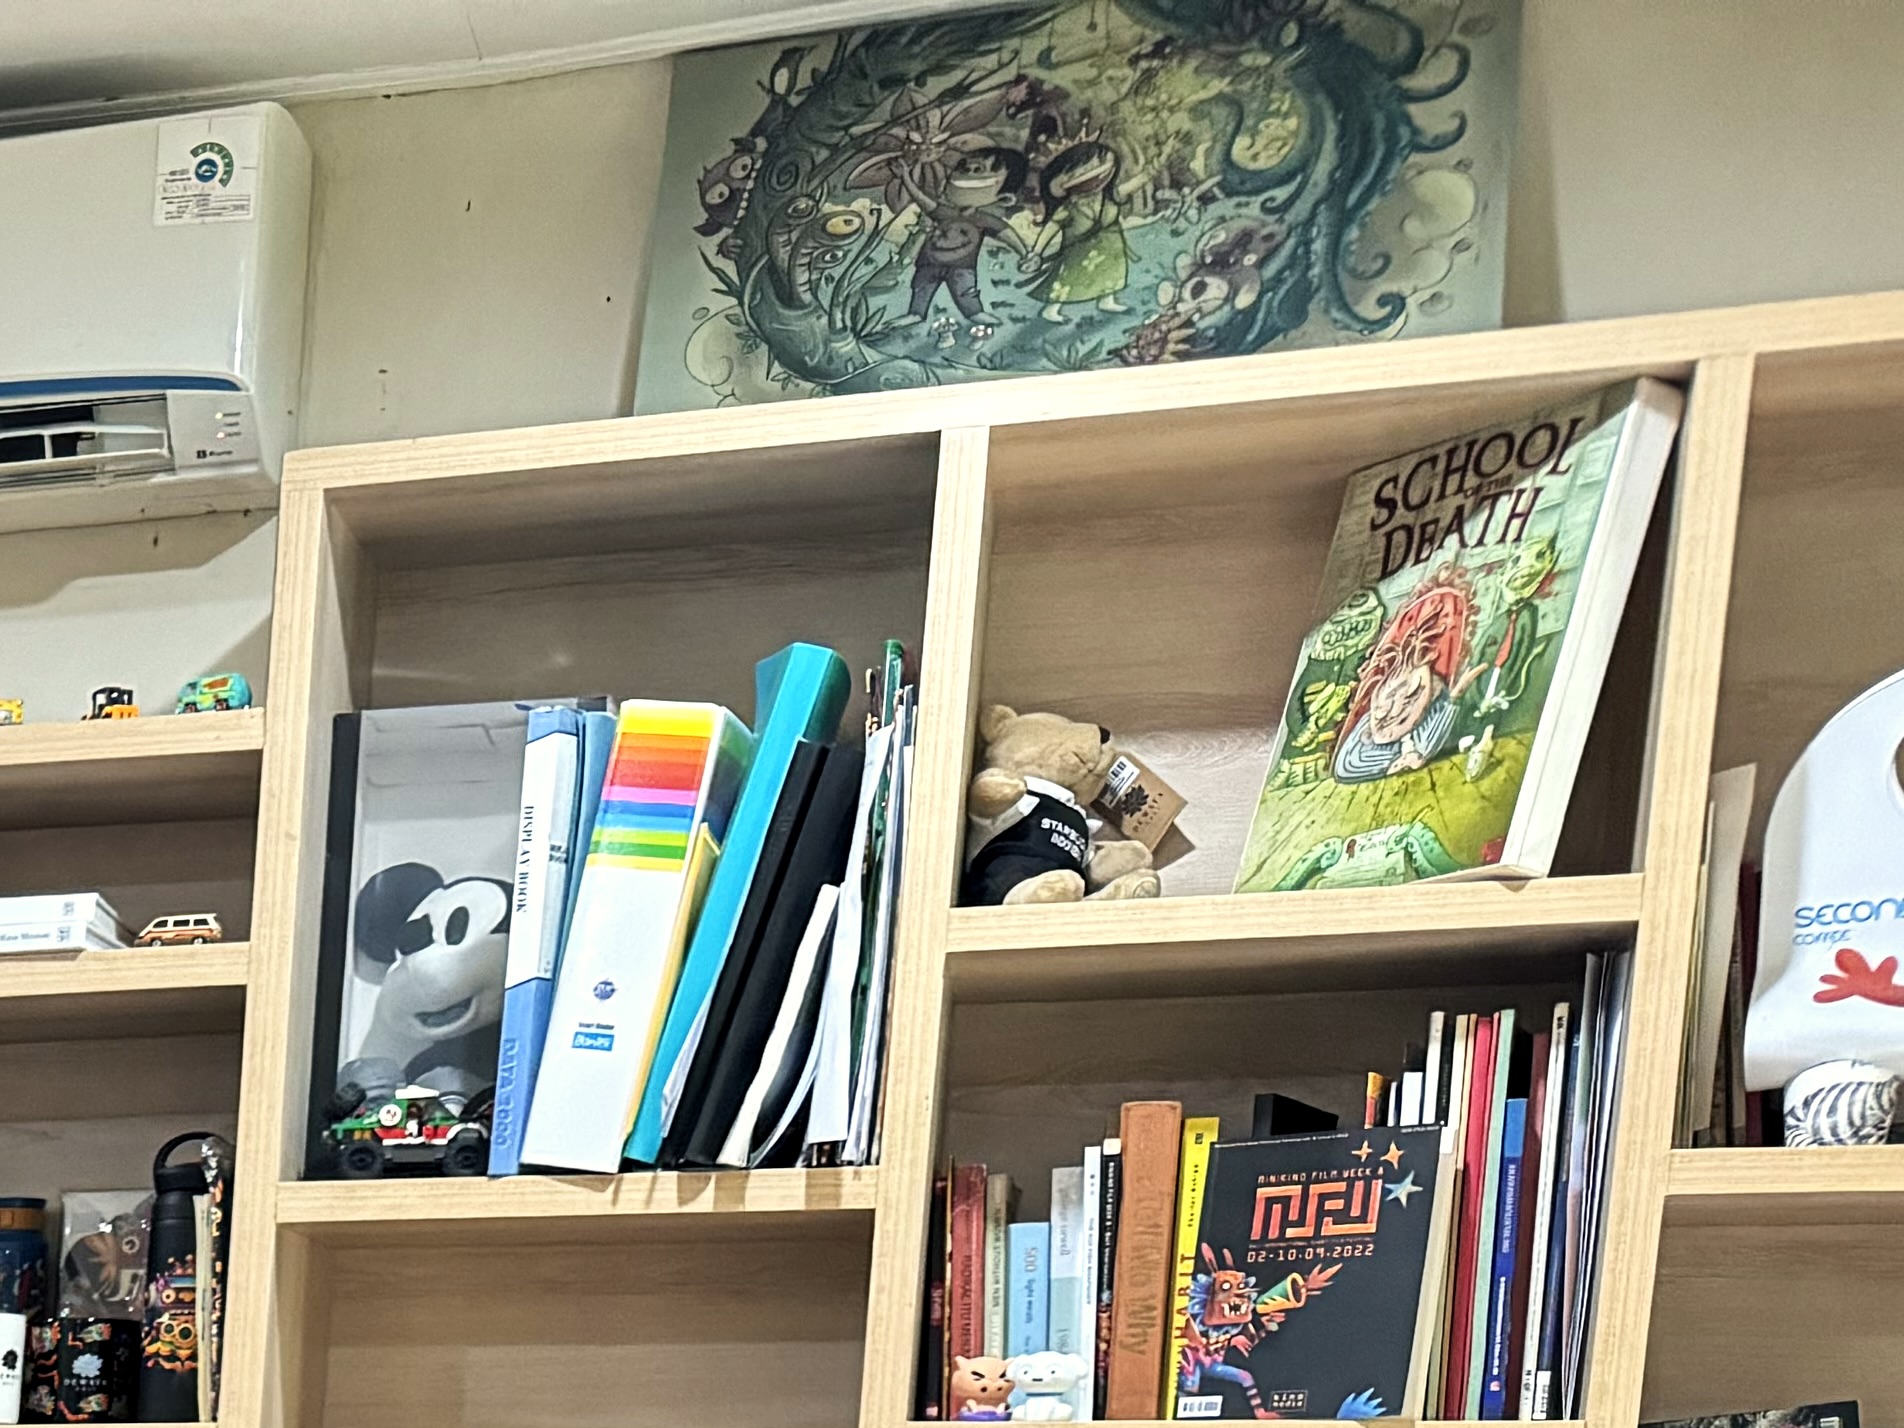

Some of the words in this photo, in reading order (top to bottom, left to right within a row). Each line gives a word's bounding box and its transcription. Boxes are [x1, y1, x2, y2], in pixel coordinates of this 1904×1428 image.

[1371, 417, 1585, 531] SCHOOL
[1379, 486, 1544, 580] DEATH
[519, 804, 535, 869] DISPLAY
[515, 871, 531, 913] BOOK
[1311, 1169, 1338, 1181] FILM
[1342, 1168, 1375, 1179] WEEK
